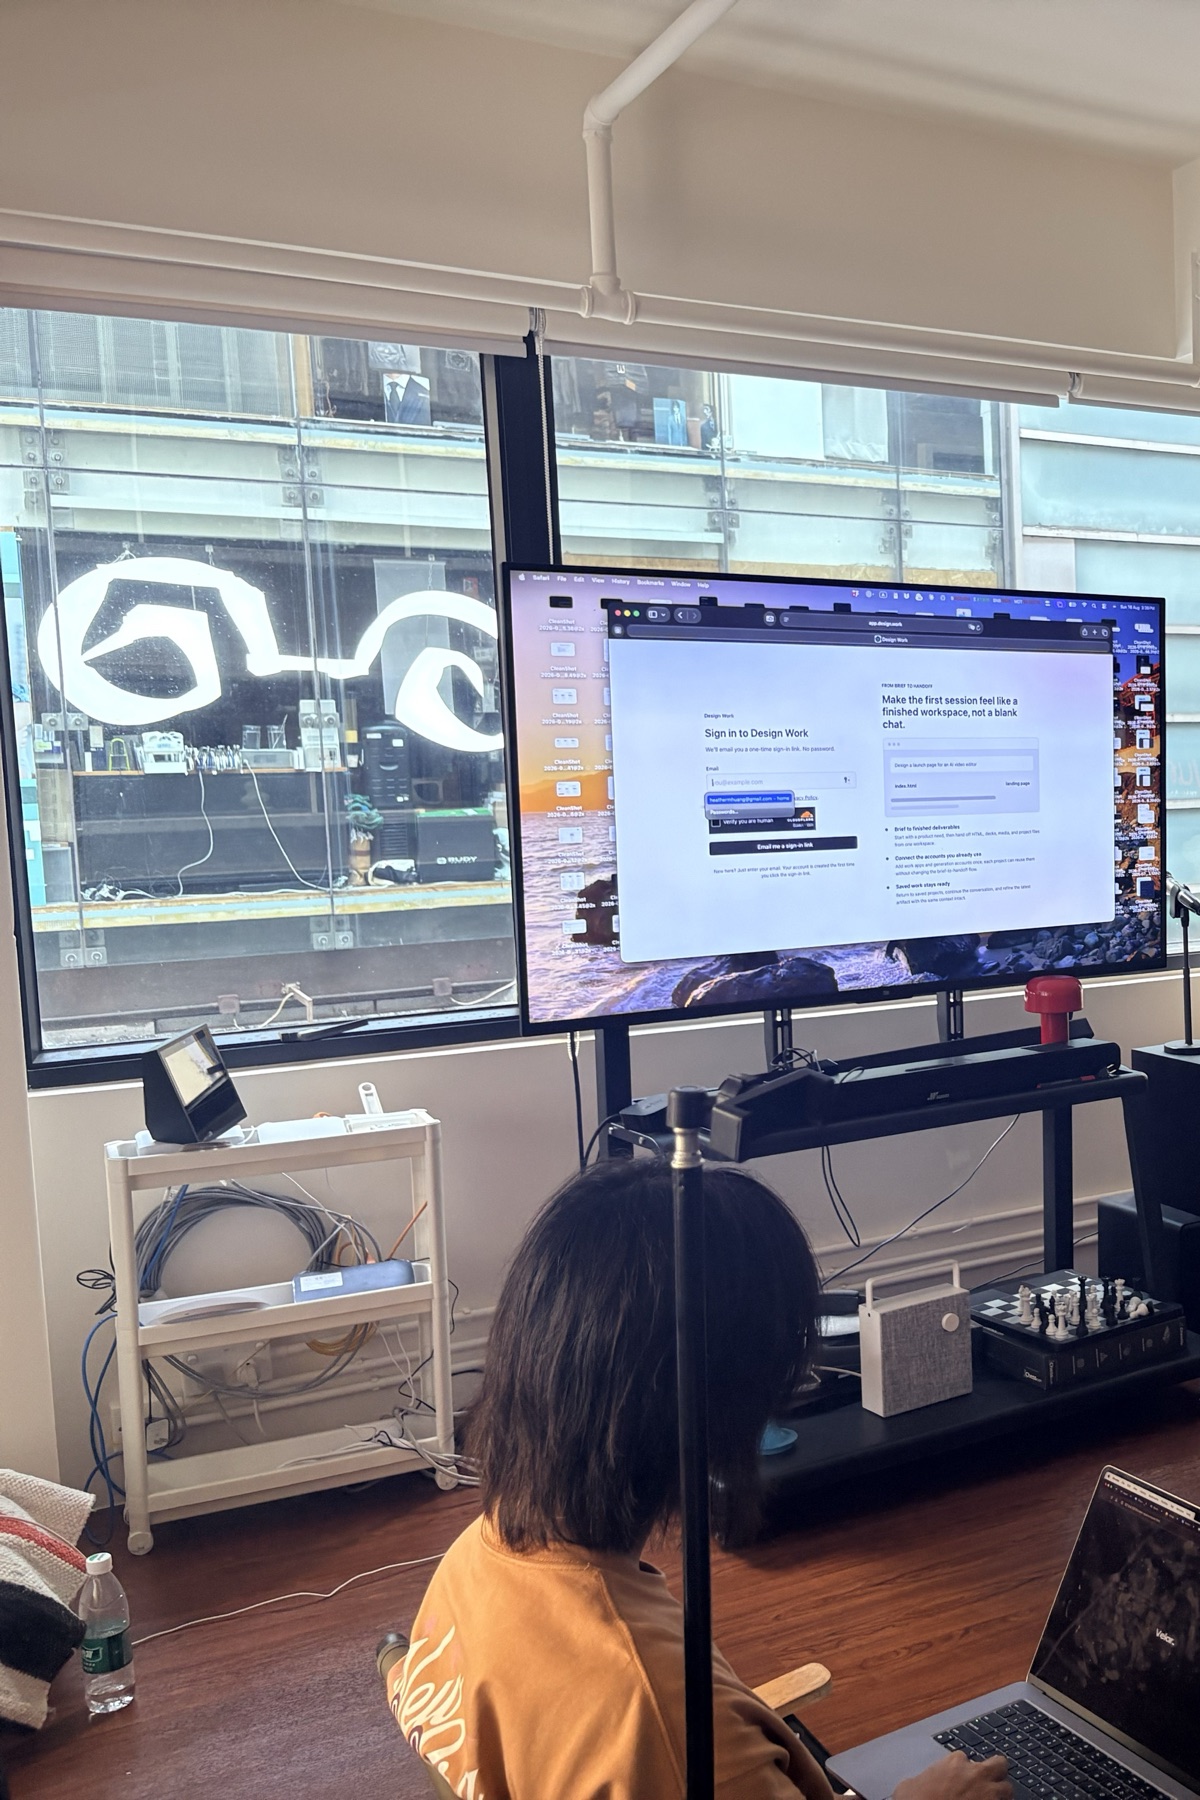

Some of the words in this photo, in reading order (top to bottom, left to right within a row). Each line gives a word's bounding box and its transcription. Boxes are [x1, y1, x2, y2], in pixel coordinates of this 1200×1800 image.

[882, 695, 906, 704] Make
[909, 696, 923, 704] the
[925, 696, 943, 704] first
[945, 696, 977, 705] session
[980, 696, 995, 705] feel
[997, 697, 1011, 705] like
[882, 707, 918, 716] finished
[921, 708, 970, 718] workspace,
[883, 720, 905, 729] chat.
[705, 729, 726, 739] Sign
[728, 729, 736, 737] in
[739, 729, 748, 737] to
[751, 729, 783, 739] Design
[785, 729, 808, 737] Work
